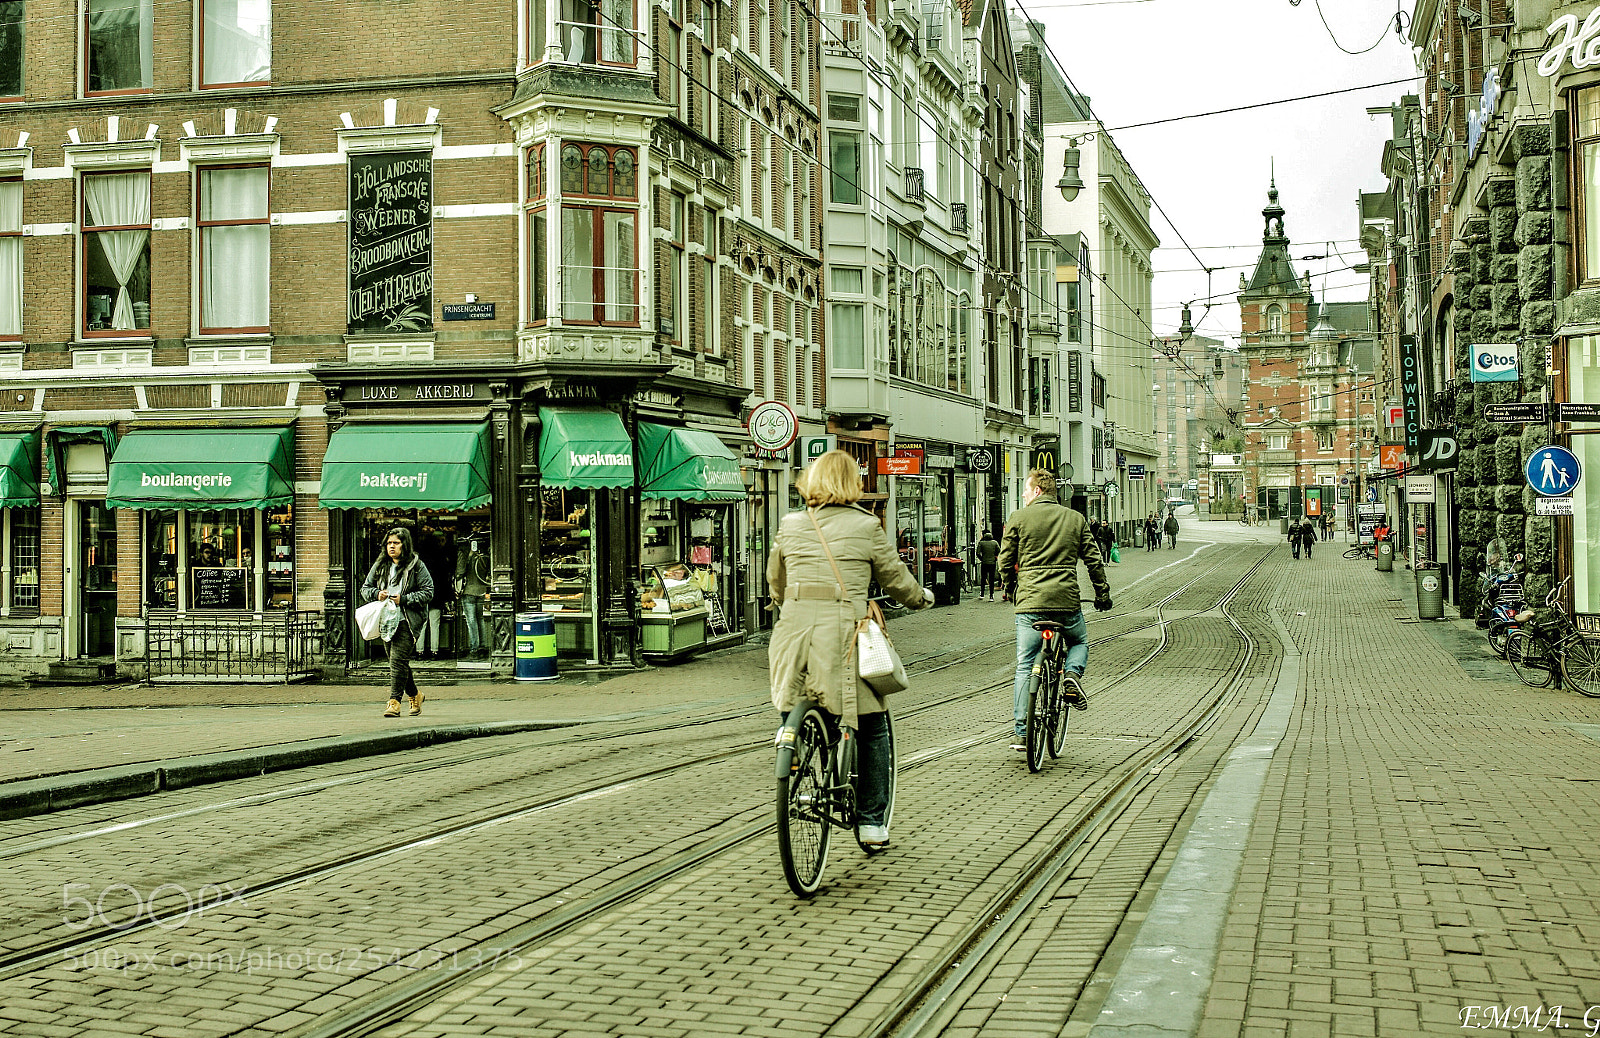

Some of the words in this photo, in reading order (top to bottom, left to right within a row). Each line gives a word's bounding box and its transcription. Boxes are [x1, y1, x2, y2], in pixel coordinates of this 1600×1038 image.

[353, 159, 431, 201] HOLLANDSCHE
[374, 177, 429, 209] FRANSCHE
[359, 207, 417, 232] WEENER
[350, 227, 432, 275] BROODBAKKERIJ
[444, 304, 493, 313] PRINSENGRACHT
[361, 386, 399, 400] LUXE
[415, 384, 474, 399] AKKERIJ
[1403, 343, 1418, 446] TOPWATCH
[759, 413, 785, 428] D&G
[570, 450, 632, 467] kwakman
[1423, 437, 1457, 460] JD
[141, 472, 232, 491] boulangerie
[360, 472, 428, 492] bakkerij
